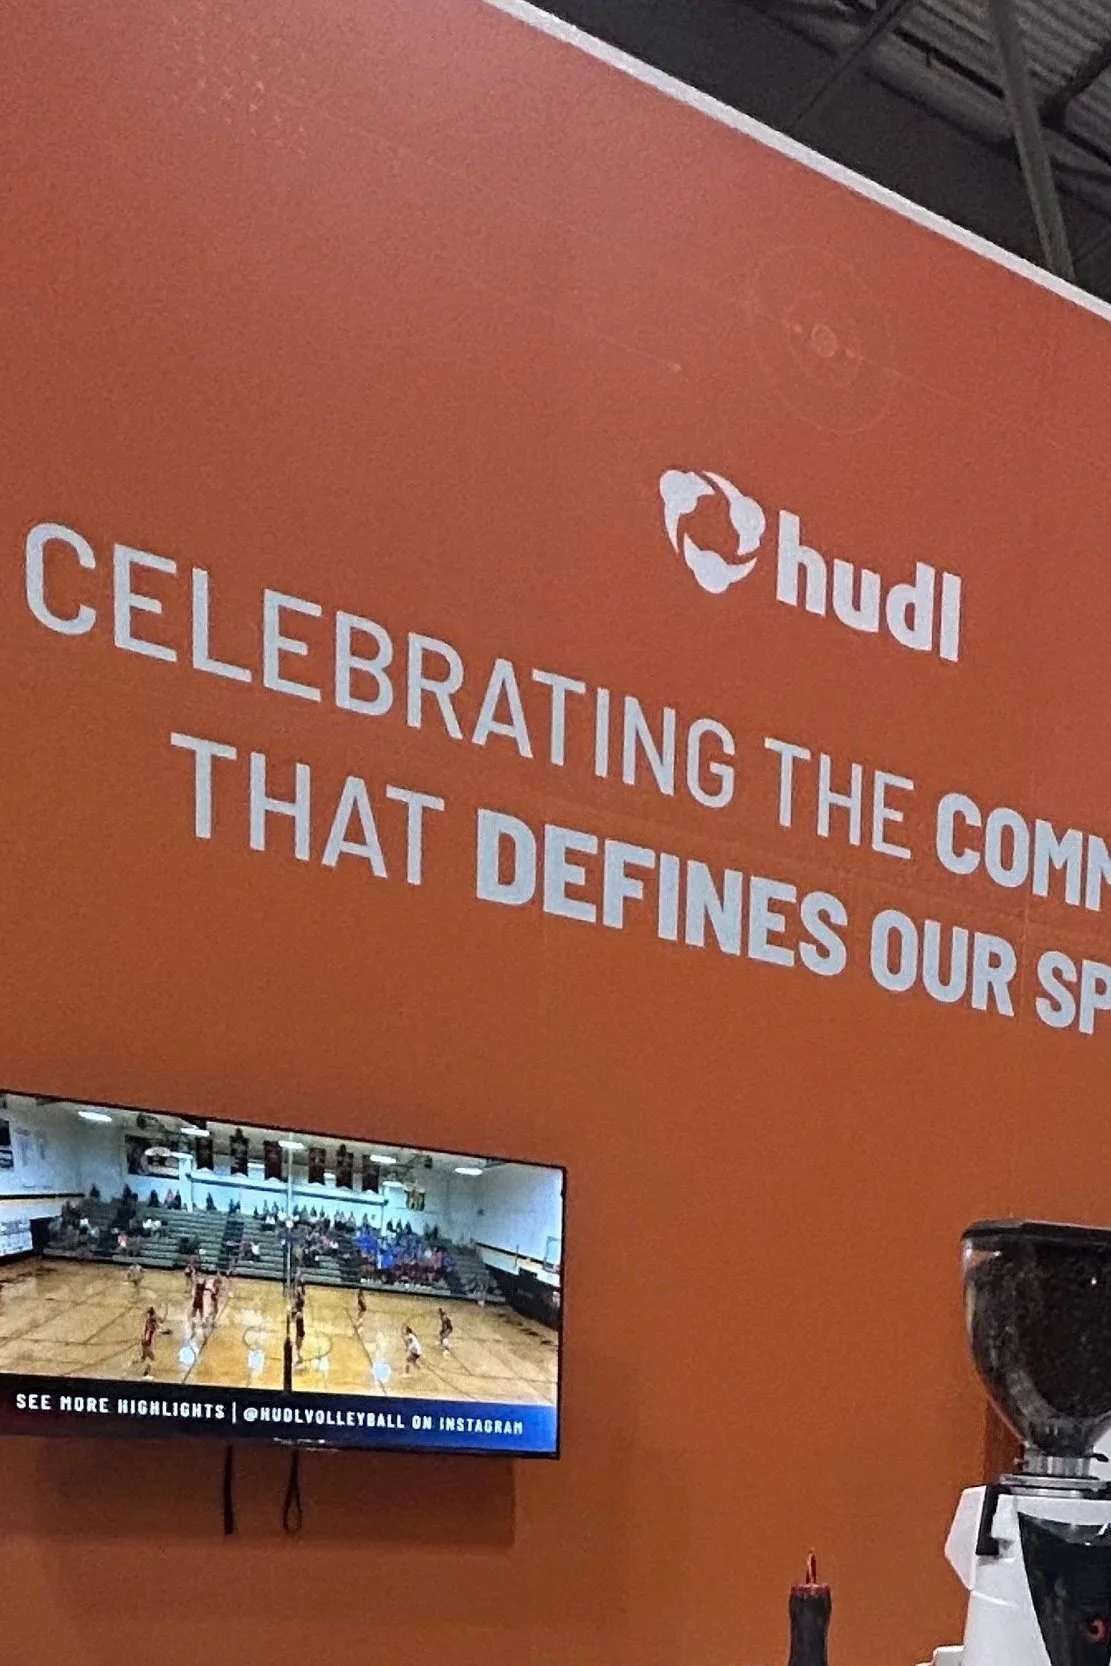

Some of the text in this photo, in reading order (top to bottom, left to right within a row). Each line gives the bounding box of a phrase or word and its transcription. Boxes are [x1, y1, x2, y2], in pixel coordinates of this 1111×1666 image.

[25, 522, 736, 809] CELEBRATING
[764, 737, 914, 860] THE
[775, 510, 962, 662] hudl
[170, 731, 445, 886] THAT
[476, 808, 848, 977] DEFINES
[870, 909, 1016, 1017] OUR
[15, 1393, 52, 1410] SEE
[60, 1396, 109, 1414] MORE
[117, 1398, 225, 1420] HIGHLIGHTS
[242, 1407, 405, 1430] @HUDLVOLLEYBALL
[412, 1415, 433, 1430] ON
[439, 1417, 524, 1436] INSTAGRAM
